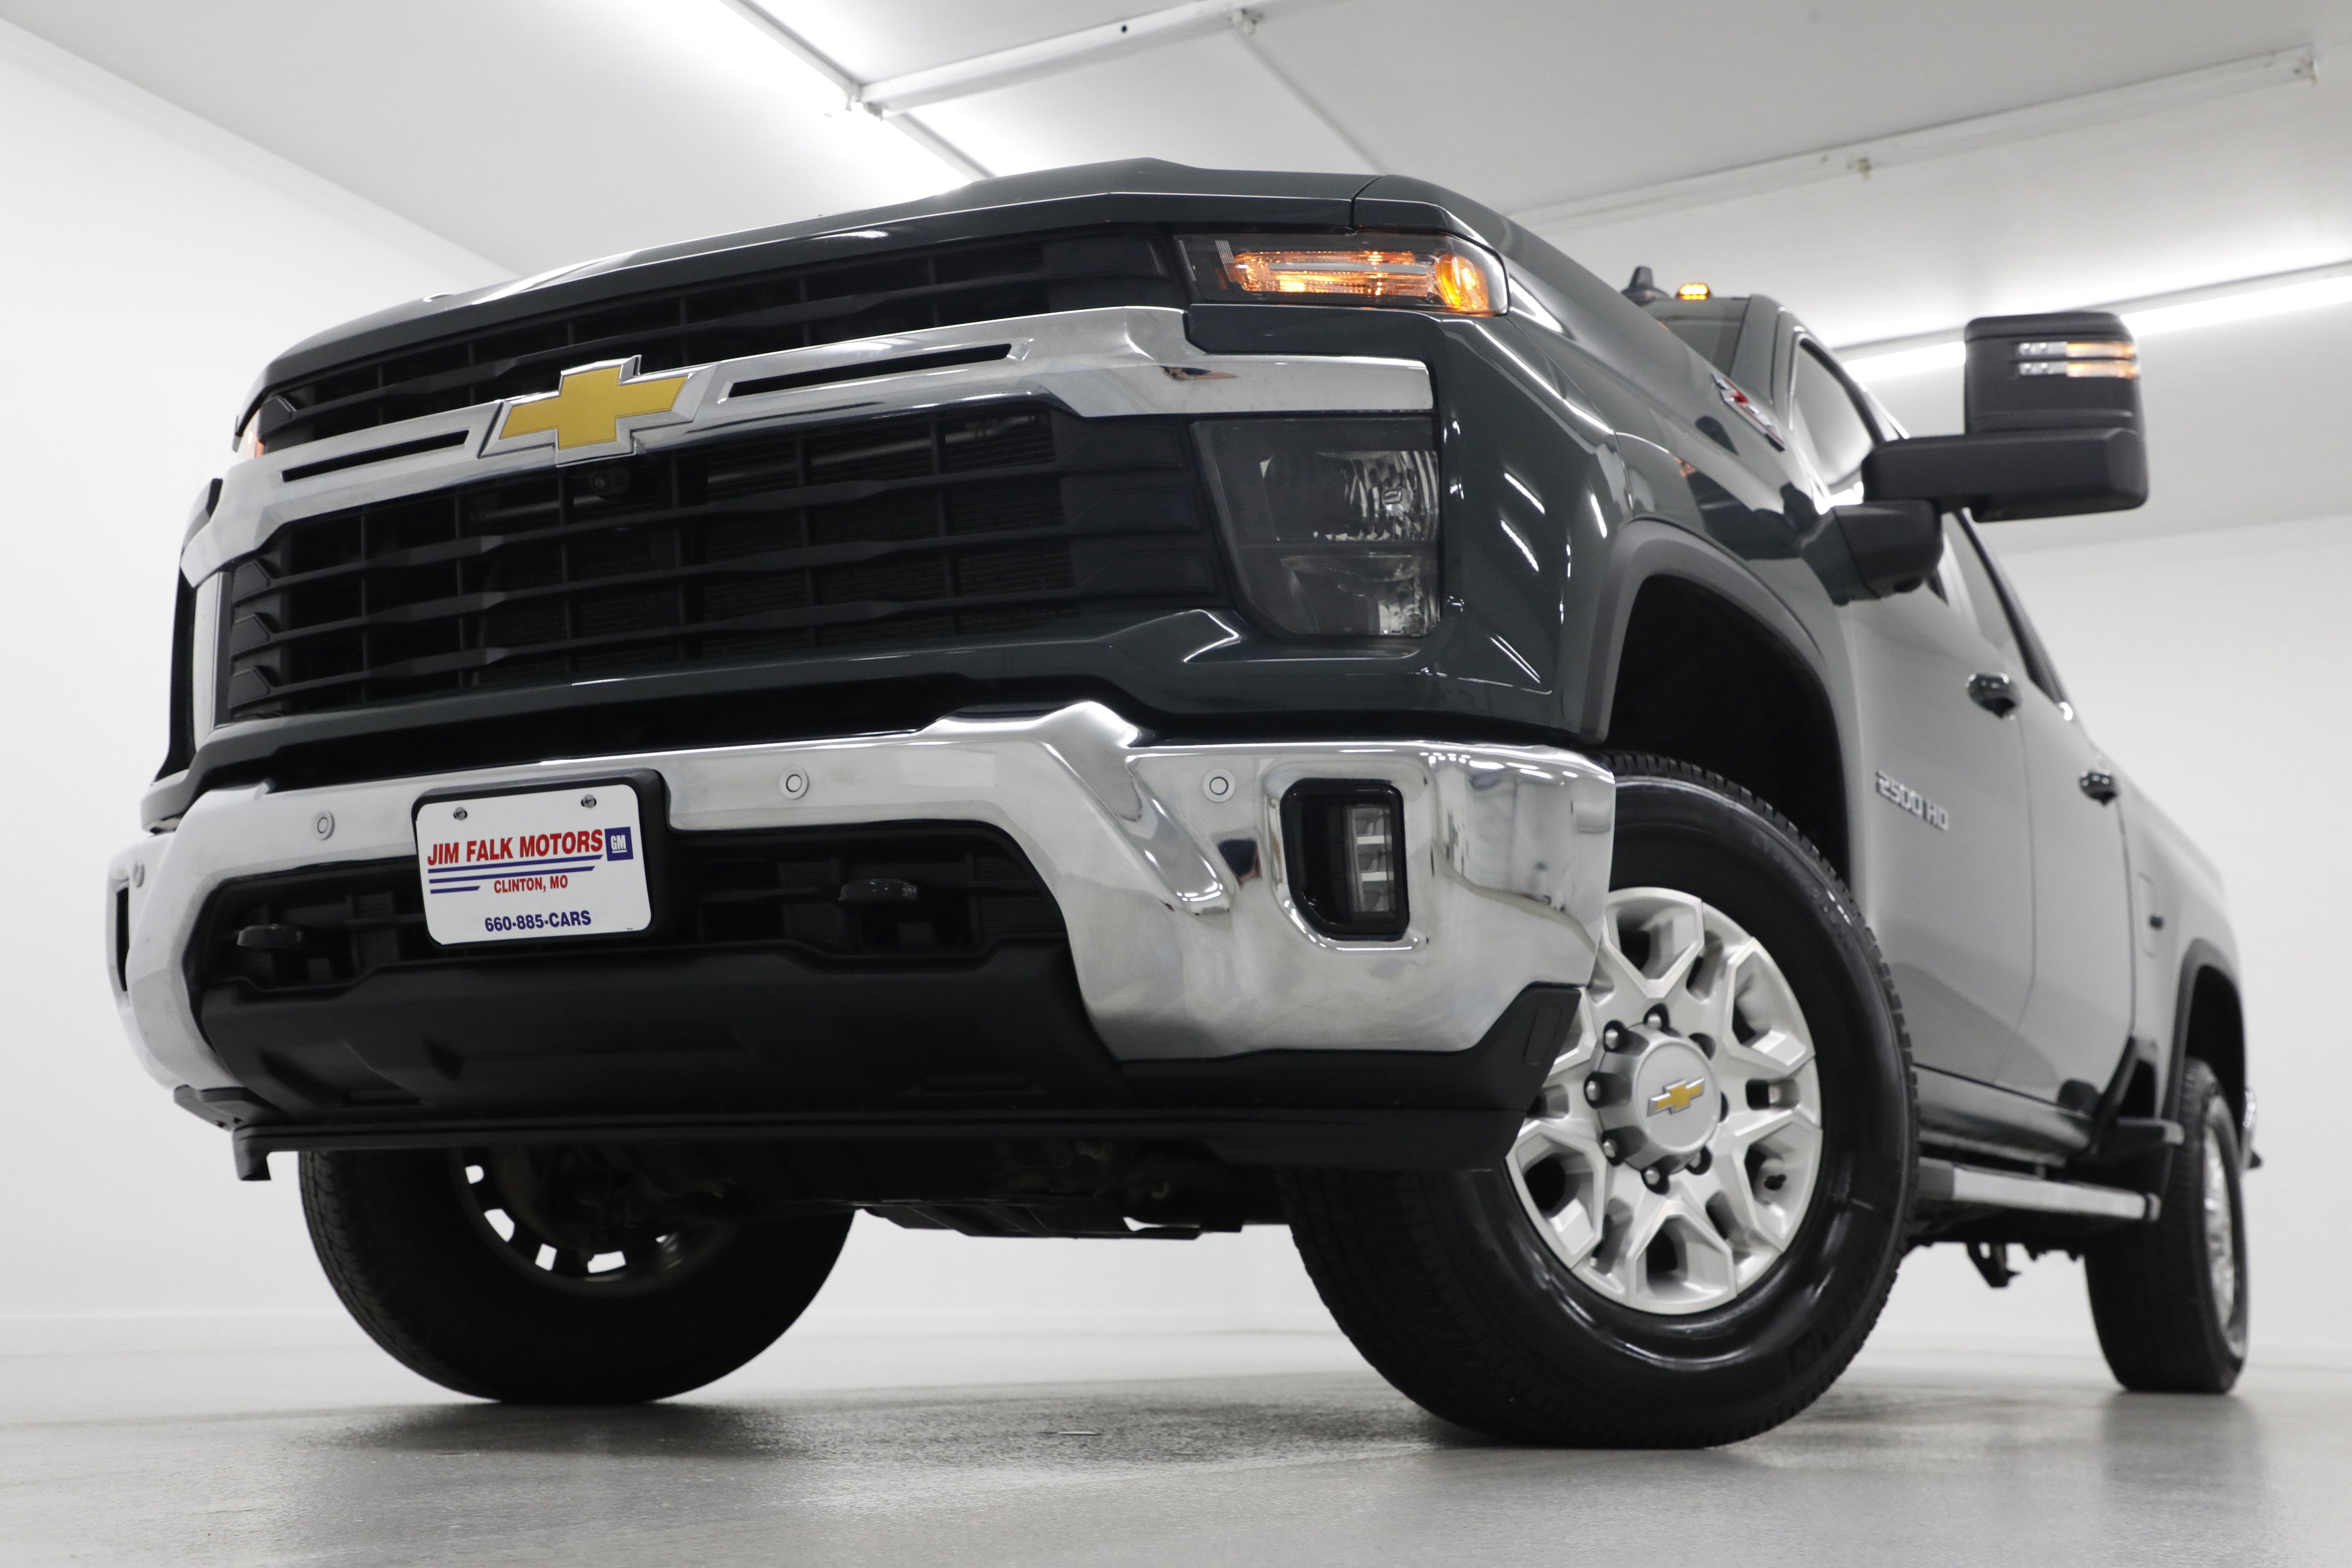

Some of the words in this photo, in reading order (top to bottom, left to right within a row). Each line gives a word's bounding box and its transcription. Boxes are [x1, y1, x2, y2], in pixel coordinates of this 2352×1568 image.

[1876, 770, 1923, 817] 2500
[1923, 798, 1949, 831] HD
[428, 842, 459, 866] JIM
[466, 837, 513, 862] FALK
[520, 829, 603, 858] MOTORS
[610, 835, 627, 851] GM
[494, 877, 546, 893] CLINTON,
[550, 875, 568, 889] MO
[485, 910, 592, 932] 660-885-CARS
